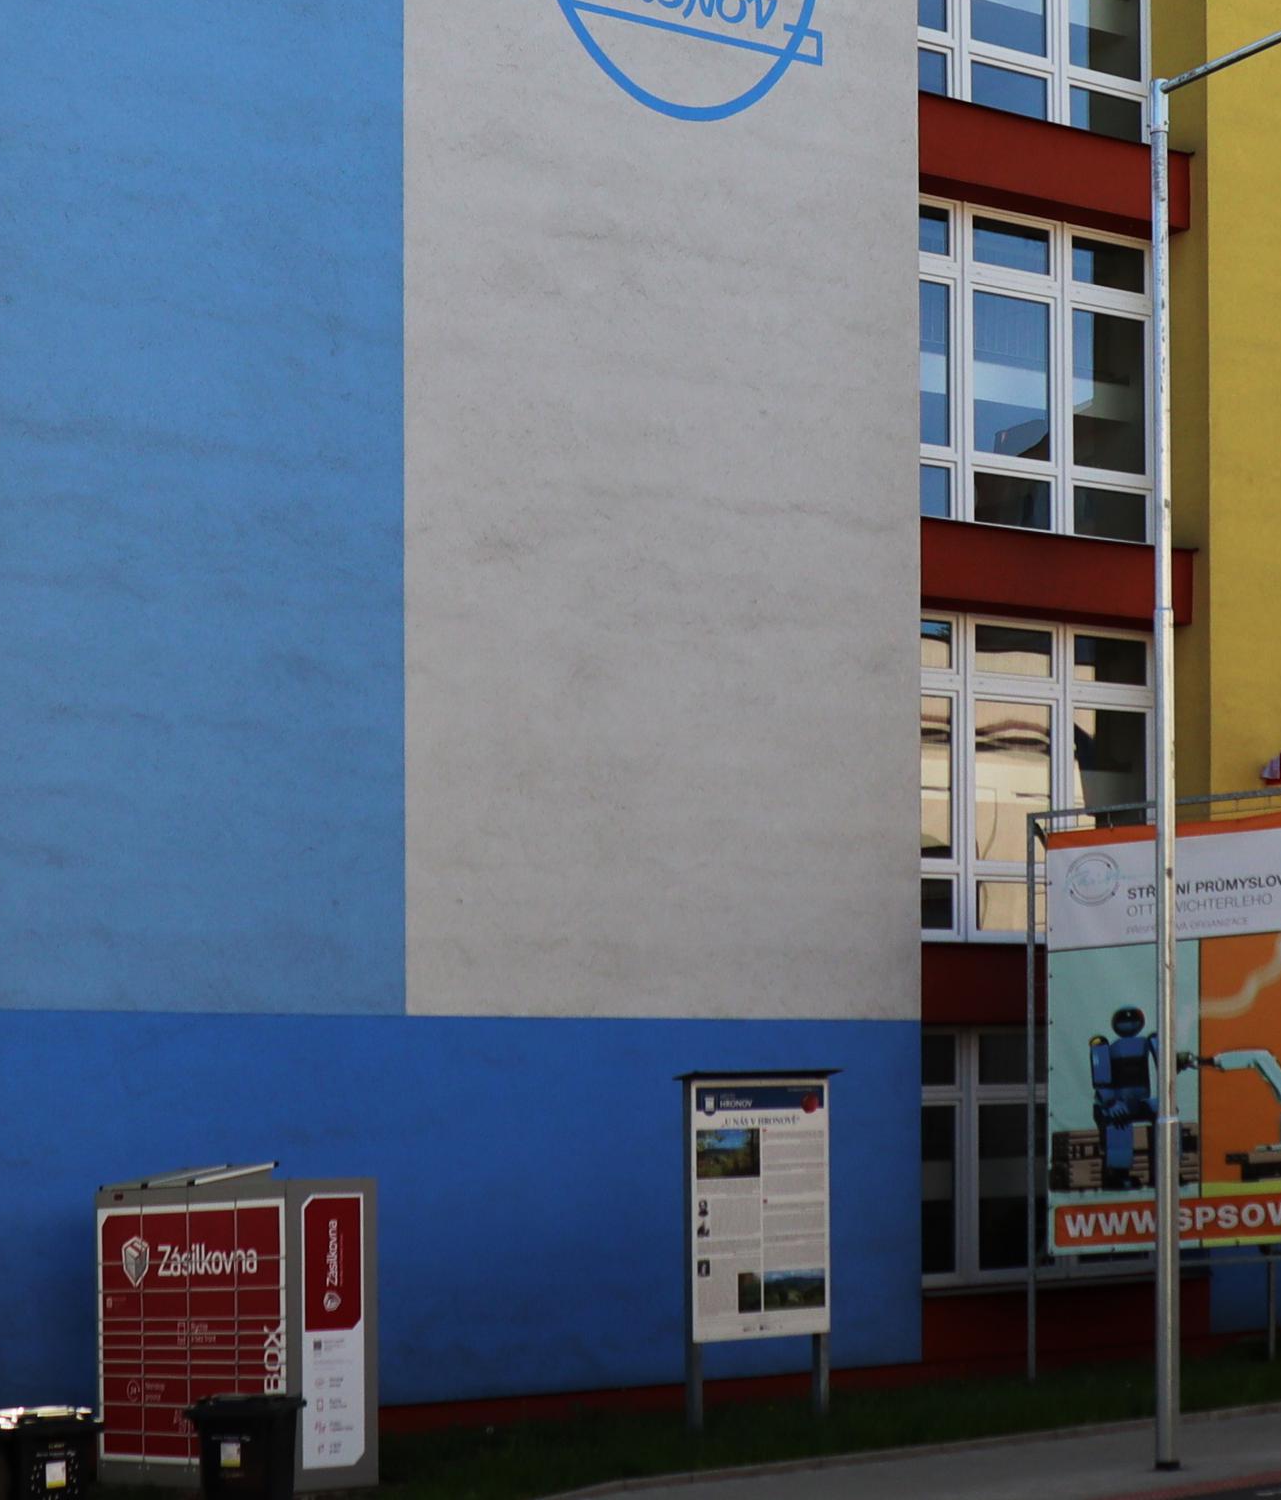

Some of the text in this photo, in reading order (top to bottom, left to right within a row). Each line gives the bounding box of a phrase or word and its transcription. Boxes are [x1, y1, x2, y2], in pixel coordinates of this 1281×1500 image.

[1127, 882, 1190, 900] STŘNÍ
[1126, 902, 1156, 918] OTT
[157, 1242, 258, 1277] Zásilkovna
